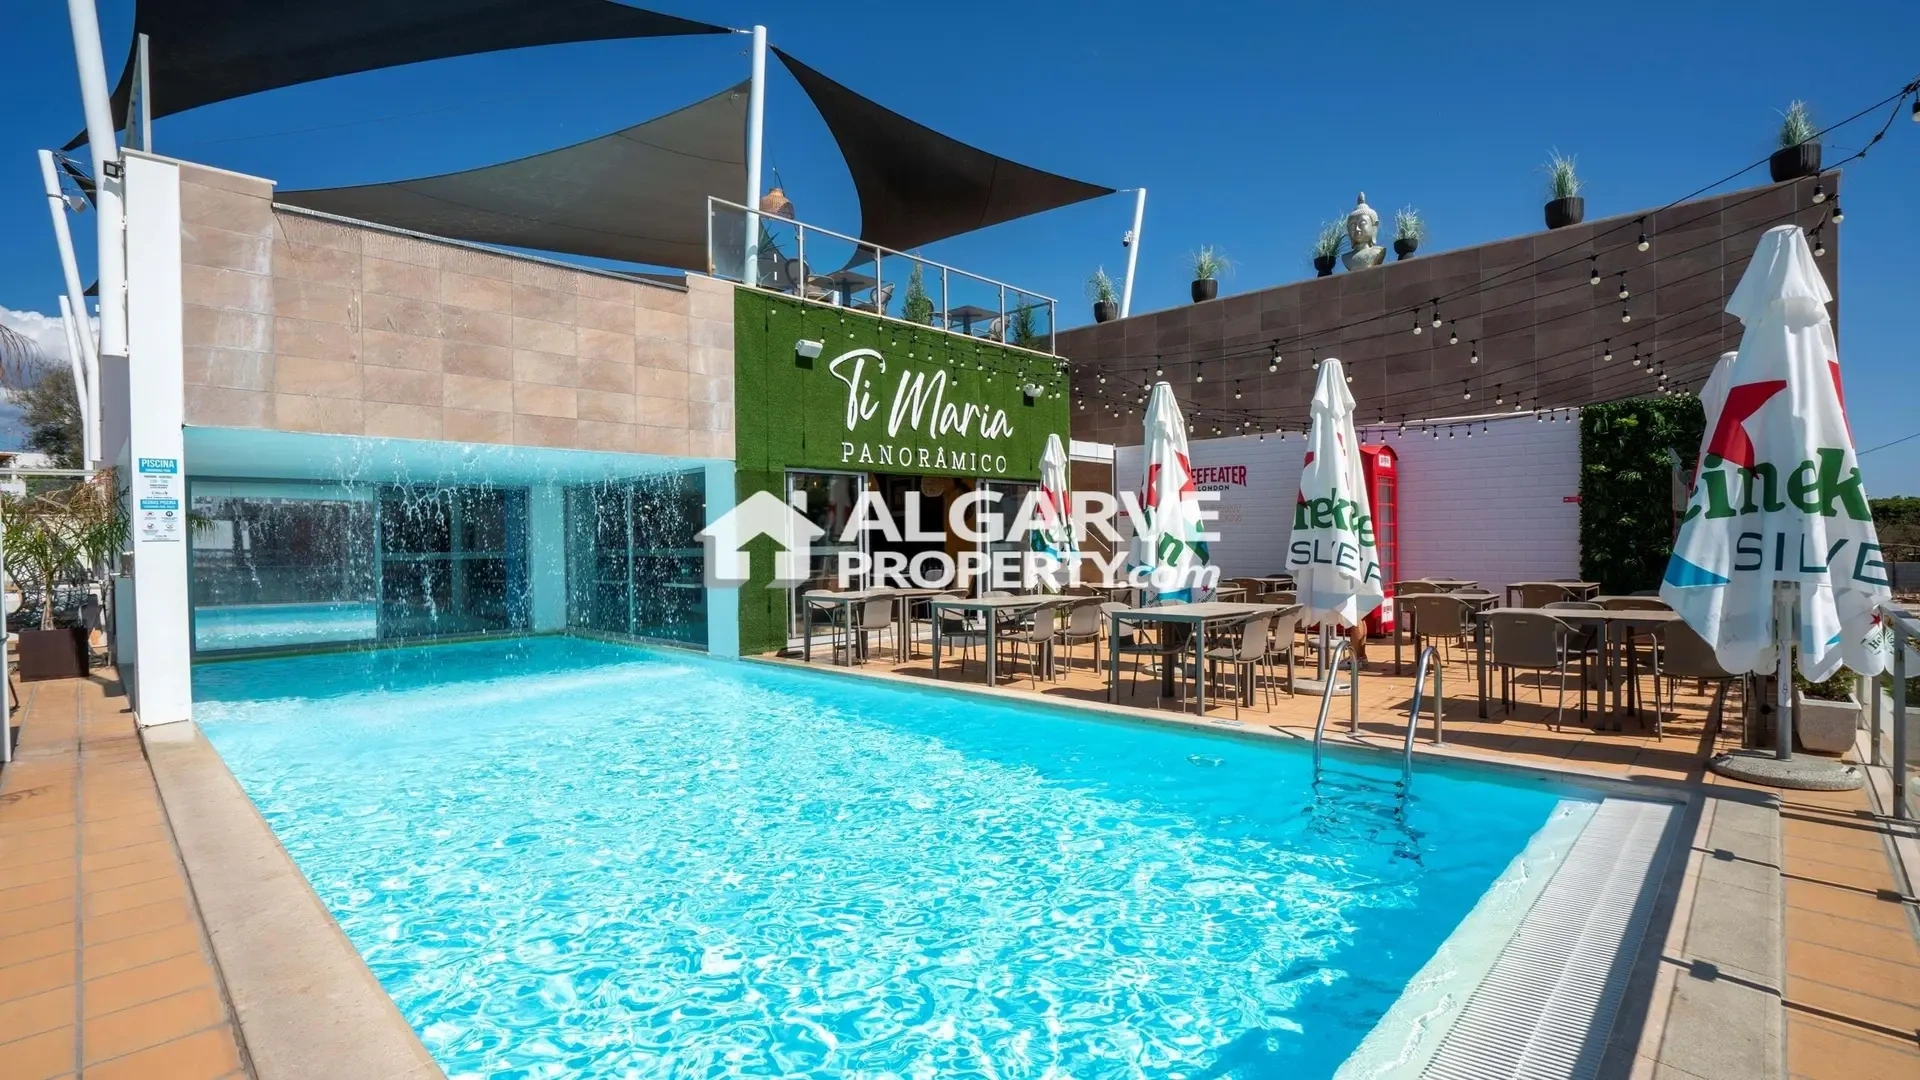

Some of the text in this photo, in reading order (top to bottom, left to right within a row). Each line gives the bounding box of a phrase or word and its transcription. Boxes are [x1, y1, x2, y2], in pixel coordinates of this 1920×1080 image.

[829, 348, 1014, 440] Ti Maria
[141, 459, 175, 469] PISCINA
[841, 441, 1008, 474] PANORÂMICO
[1191, 465, 1247, 488] EEFEATER
[1197, 484, 1230, 492] LONDON
[1682, 447, 1872, 526] inek
